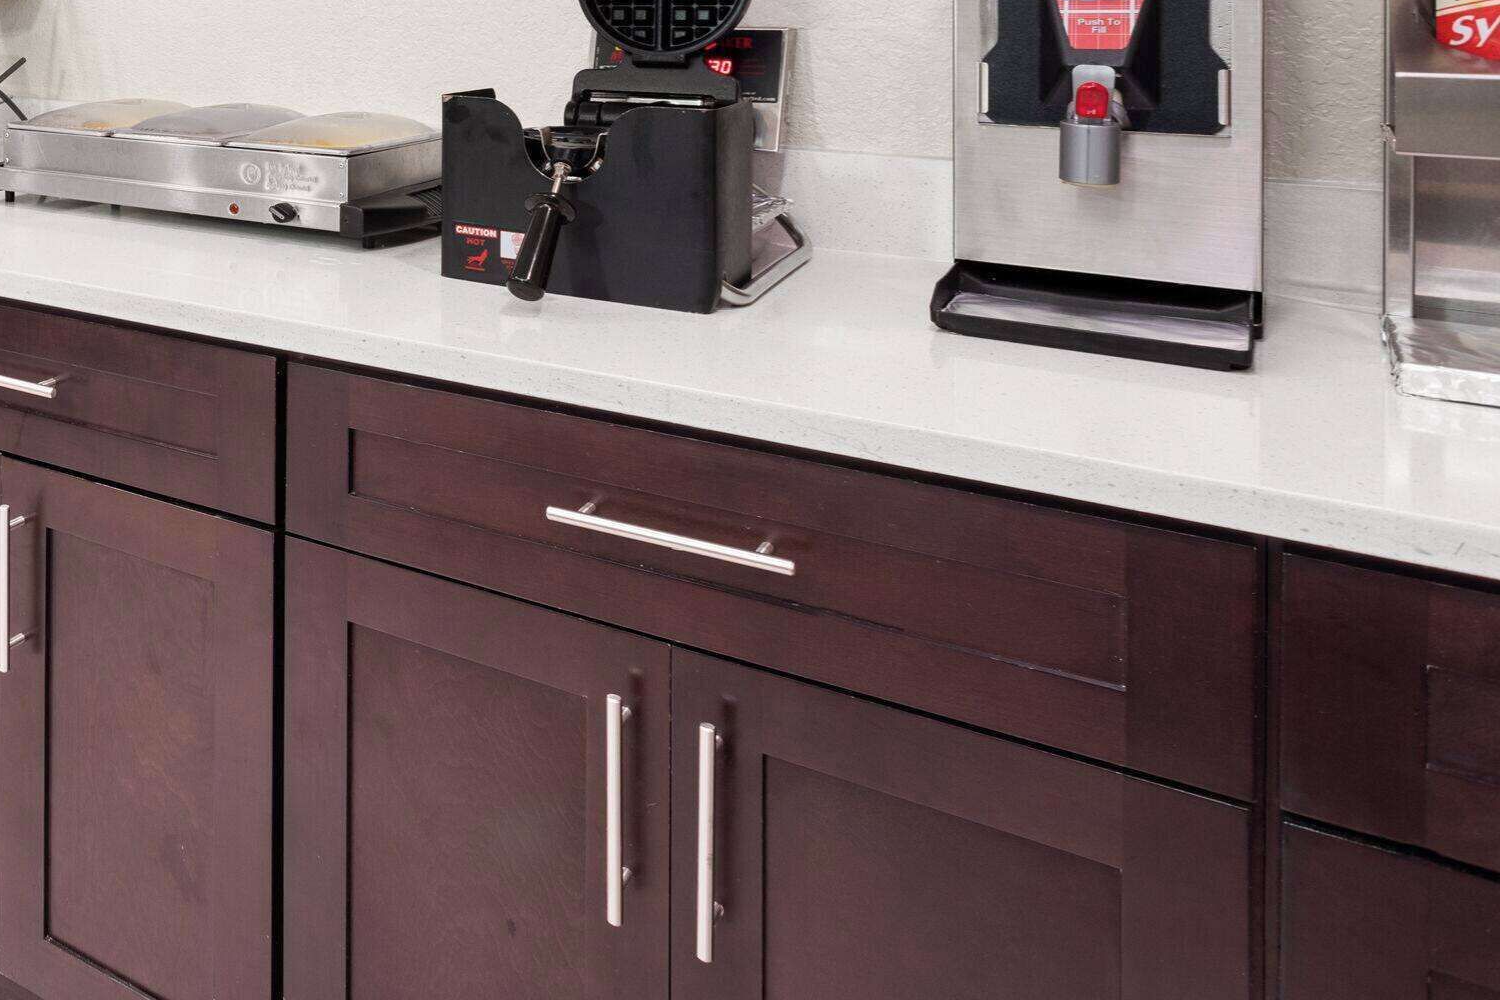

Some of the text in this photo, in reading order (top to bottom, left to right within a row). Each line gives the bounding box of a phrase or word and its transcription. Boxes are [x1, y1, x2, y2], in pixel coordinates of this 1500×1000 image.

[1077, 18, 1121, 26] Push To
[455, 225, 497, 238] CAUTION
[466, 238, 486, 246] HOT
